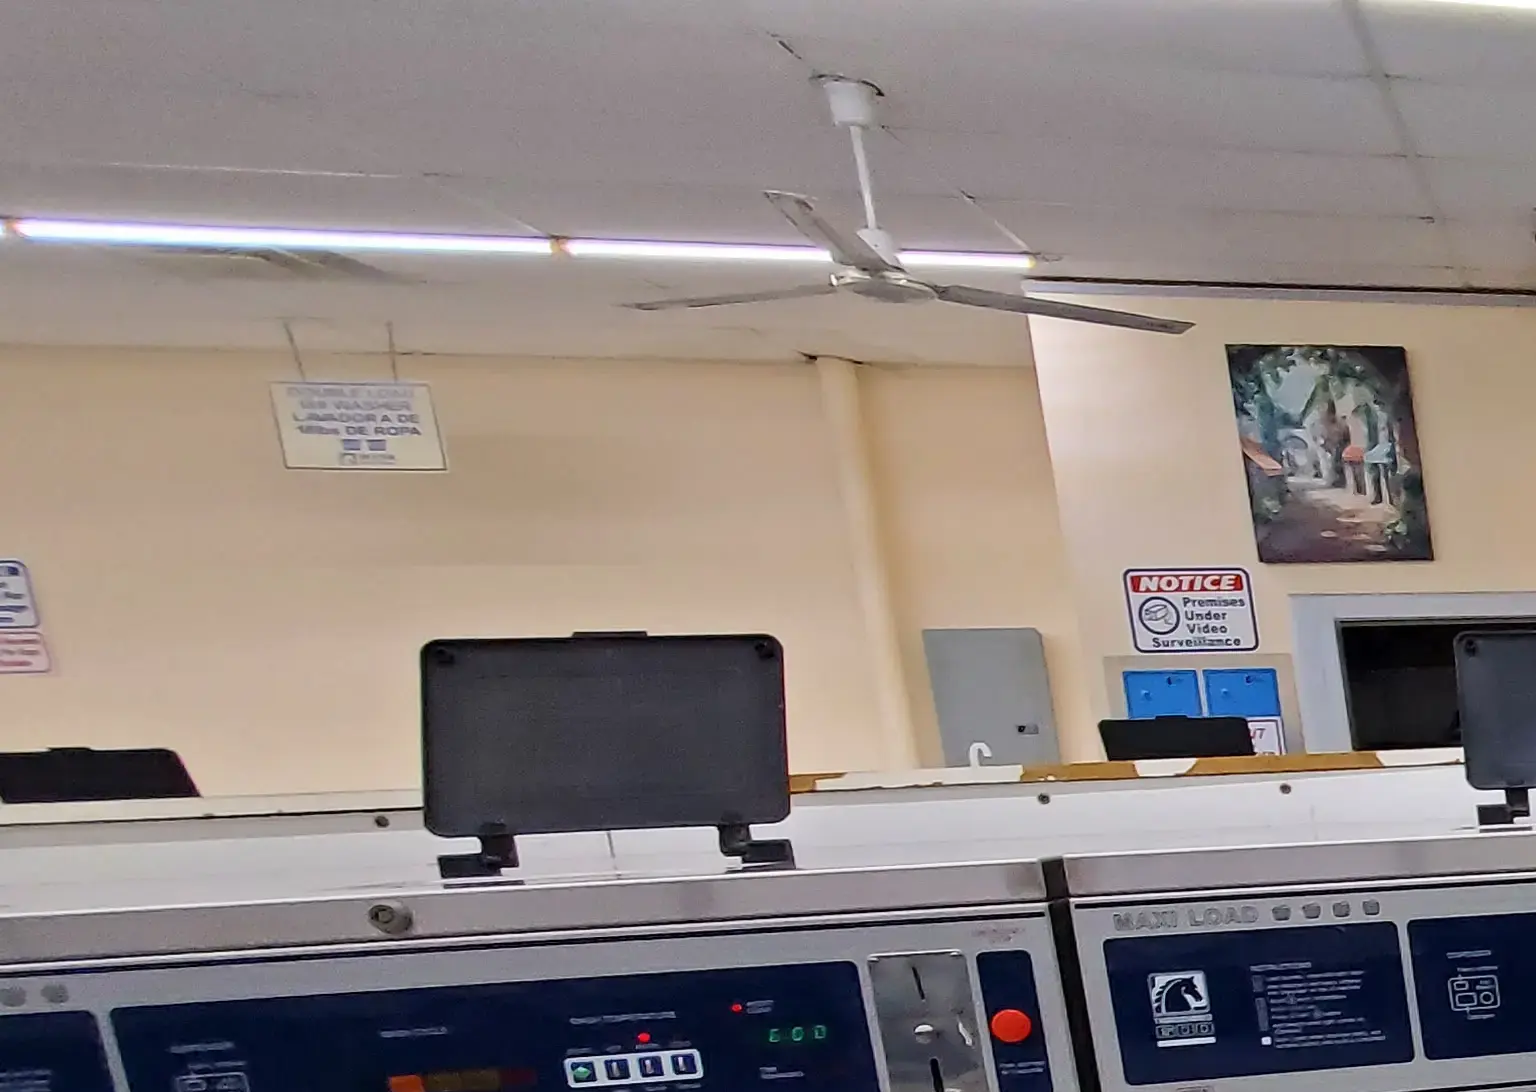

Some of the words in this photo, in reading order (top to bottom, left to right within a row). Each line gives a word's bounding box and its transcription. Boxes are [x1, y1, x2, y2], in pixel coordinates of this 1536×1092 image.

[345, 426, 370, 436] DE
[374, 426, 422, 436] ROPA
[1138, 575, 1237, 592] NOTICE
[1182, 597, 1246, 608] Premises
[1184, 611, 1228, 621] Under
[1186, 624, 1228, 634] Video
[1152, 637, 1241, 648] Surveillance
[1112, 910, 1178, 932] MAXI
[1187, 905, 1260, 928] LOAD
